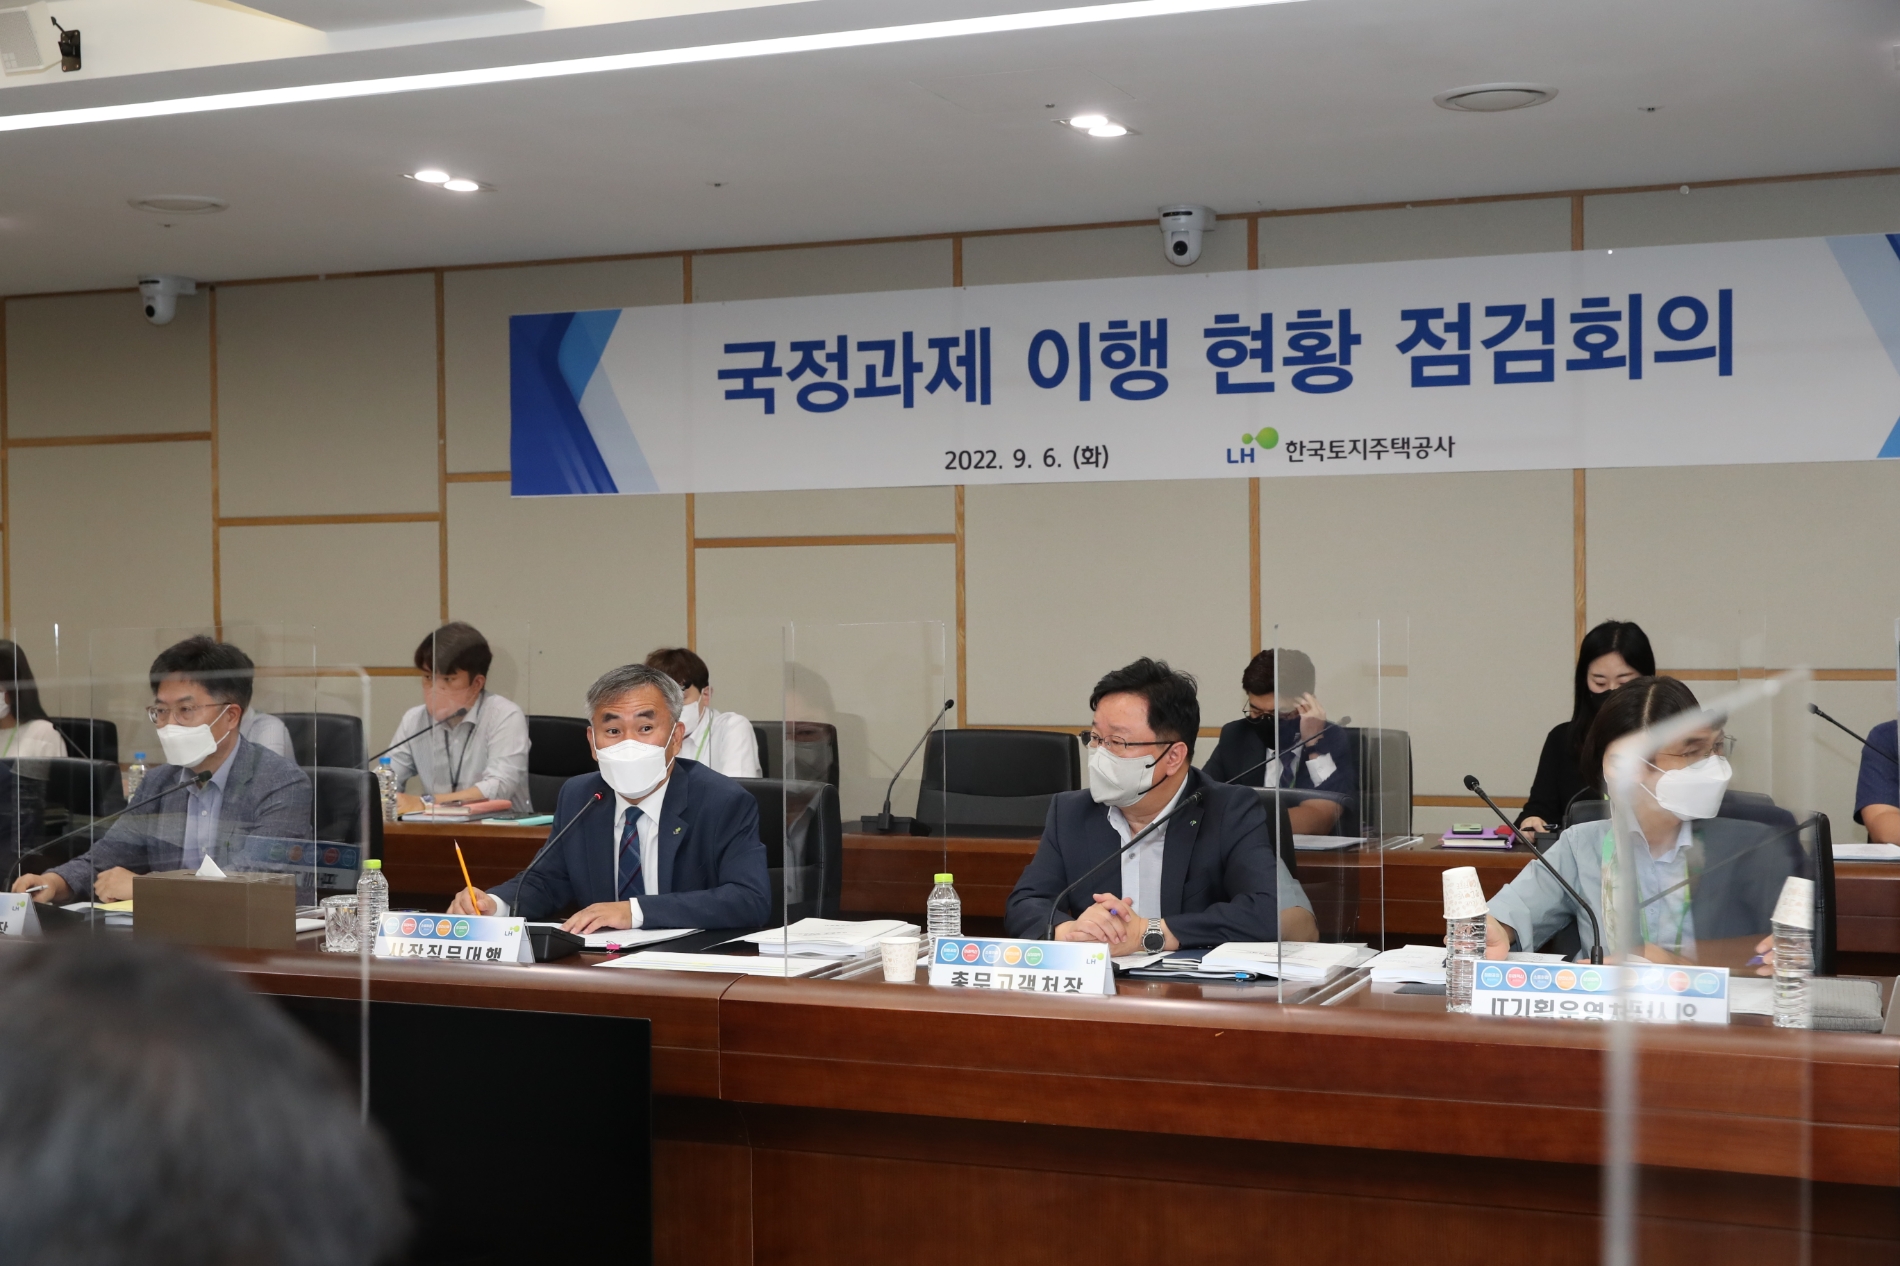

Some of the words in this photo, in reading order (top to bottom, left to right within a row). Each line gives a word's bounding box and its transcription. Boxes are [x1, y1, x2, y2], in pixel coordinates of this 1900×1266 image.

[718, 327, 991, 415] 국정과제
[1028, 318, 1169, 402] 이행
[1203, 308, 1362, 395] 현황
[1396, 289, 1733, 388] 점검회의
[944, 449, 1004, 471] 2022.
[1013, 448, 1033, 469] 9.
[1043, 447, 1063, 468] 6.
[1073, 444, 1110, 470] (화)
[1226, 448, 1255, 464] LH
[1285, 435, 1456, 463] 한국토지주택공사
